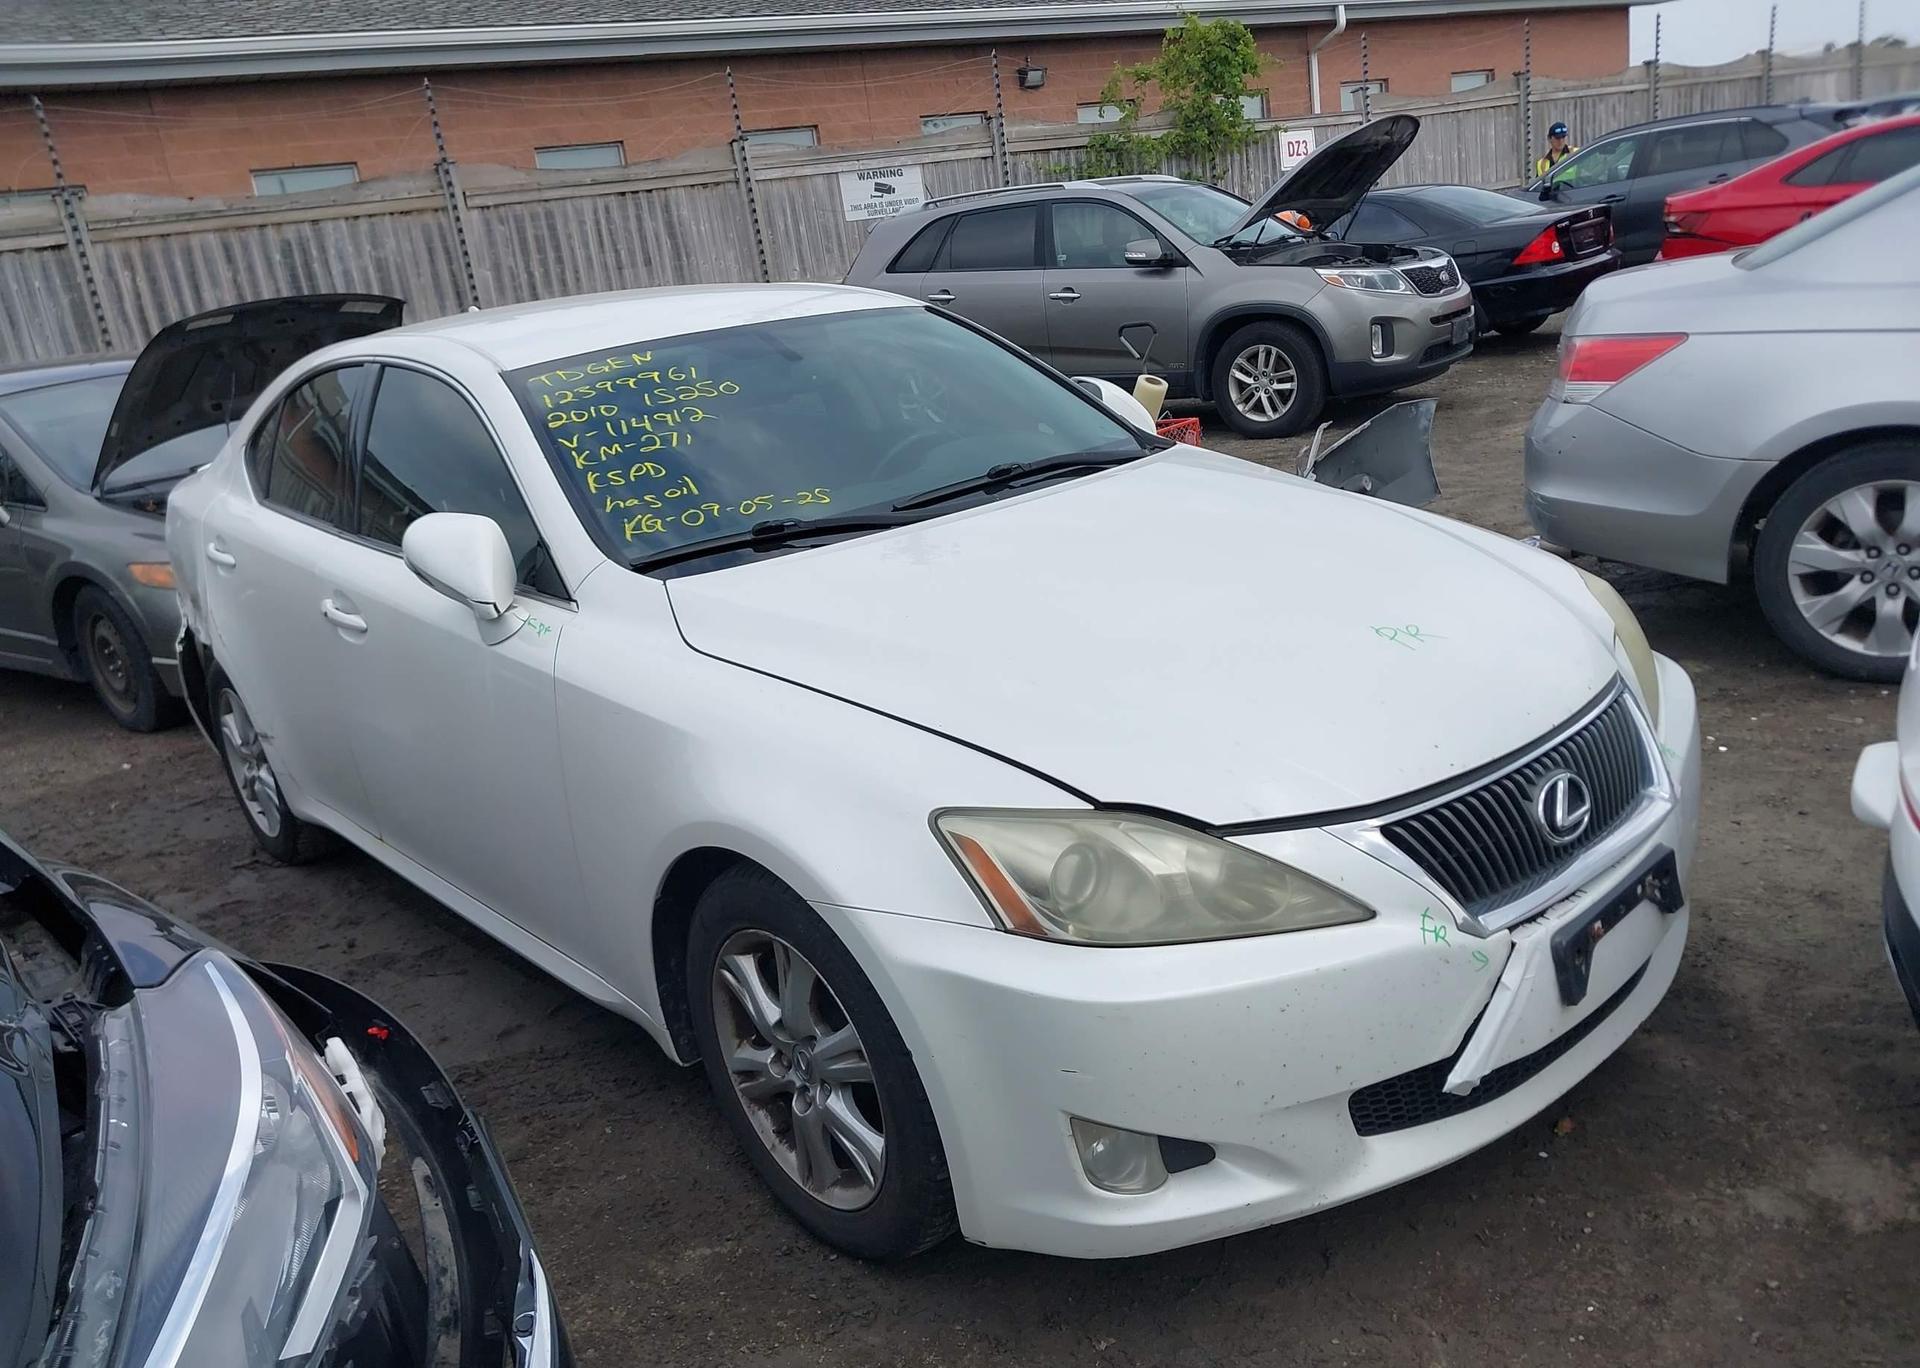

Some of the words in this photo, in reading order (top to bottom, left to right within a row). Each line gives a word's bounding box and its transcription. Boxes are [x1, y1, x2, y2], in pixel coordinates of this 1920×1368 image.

[1287, 140, 1309, 157] DZ3
[857, 168, 904, 181] WARNING
[864, 202, 877, 210] AREA
[885, 199, 902, 208] UNDER
[904, 197, 919, 206] VIDEO
[547, 405, 618, 428] 2010
